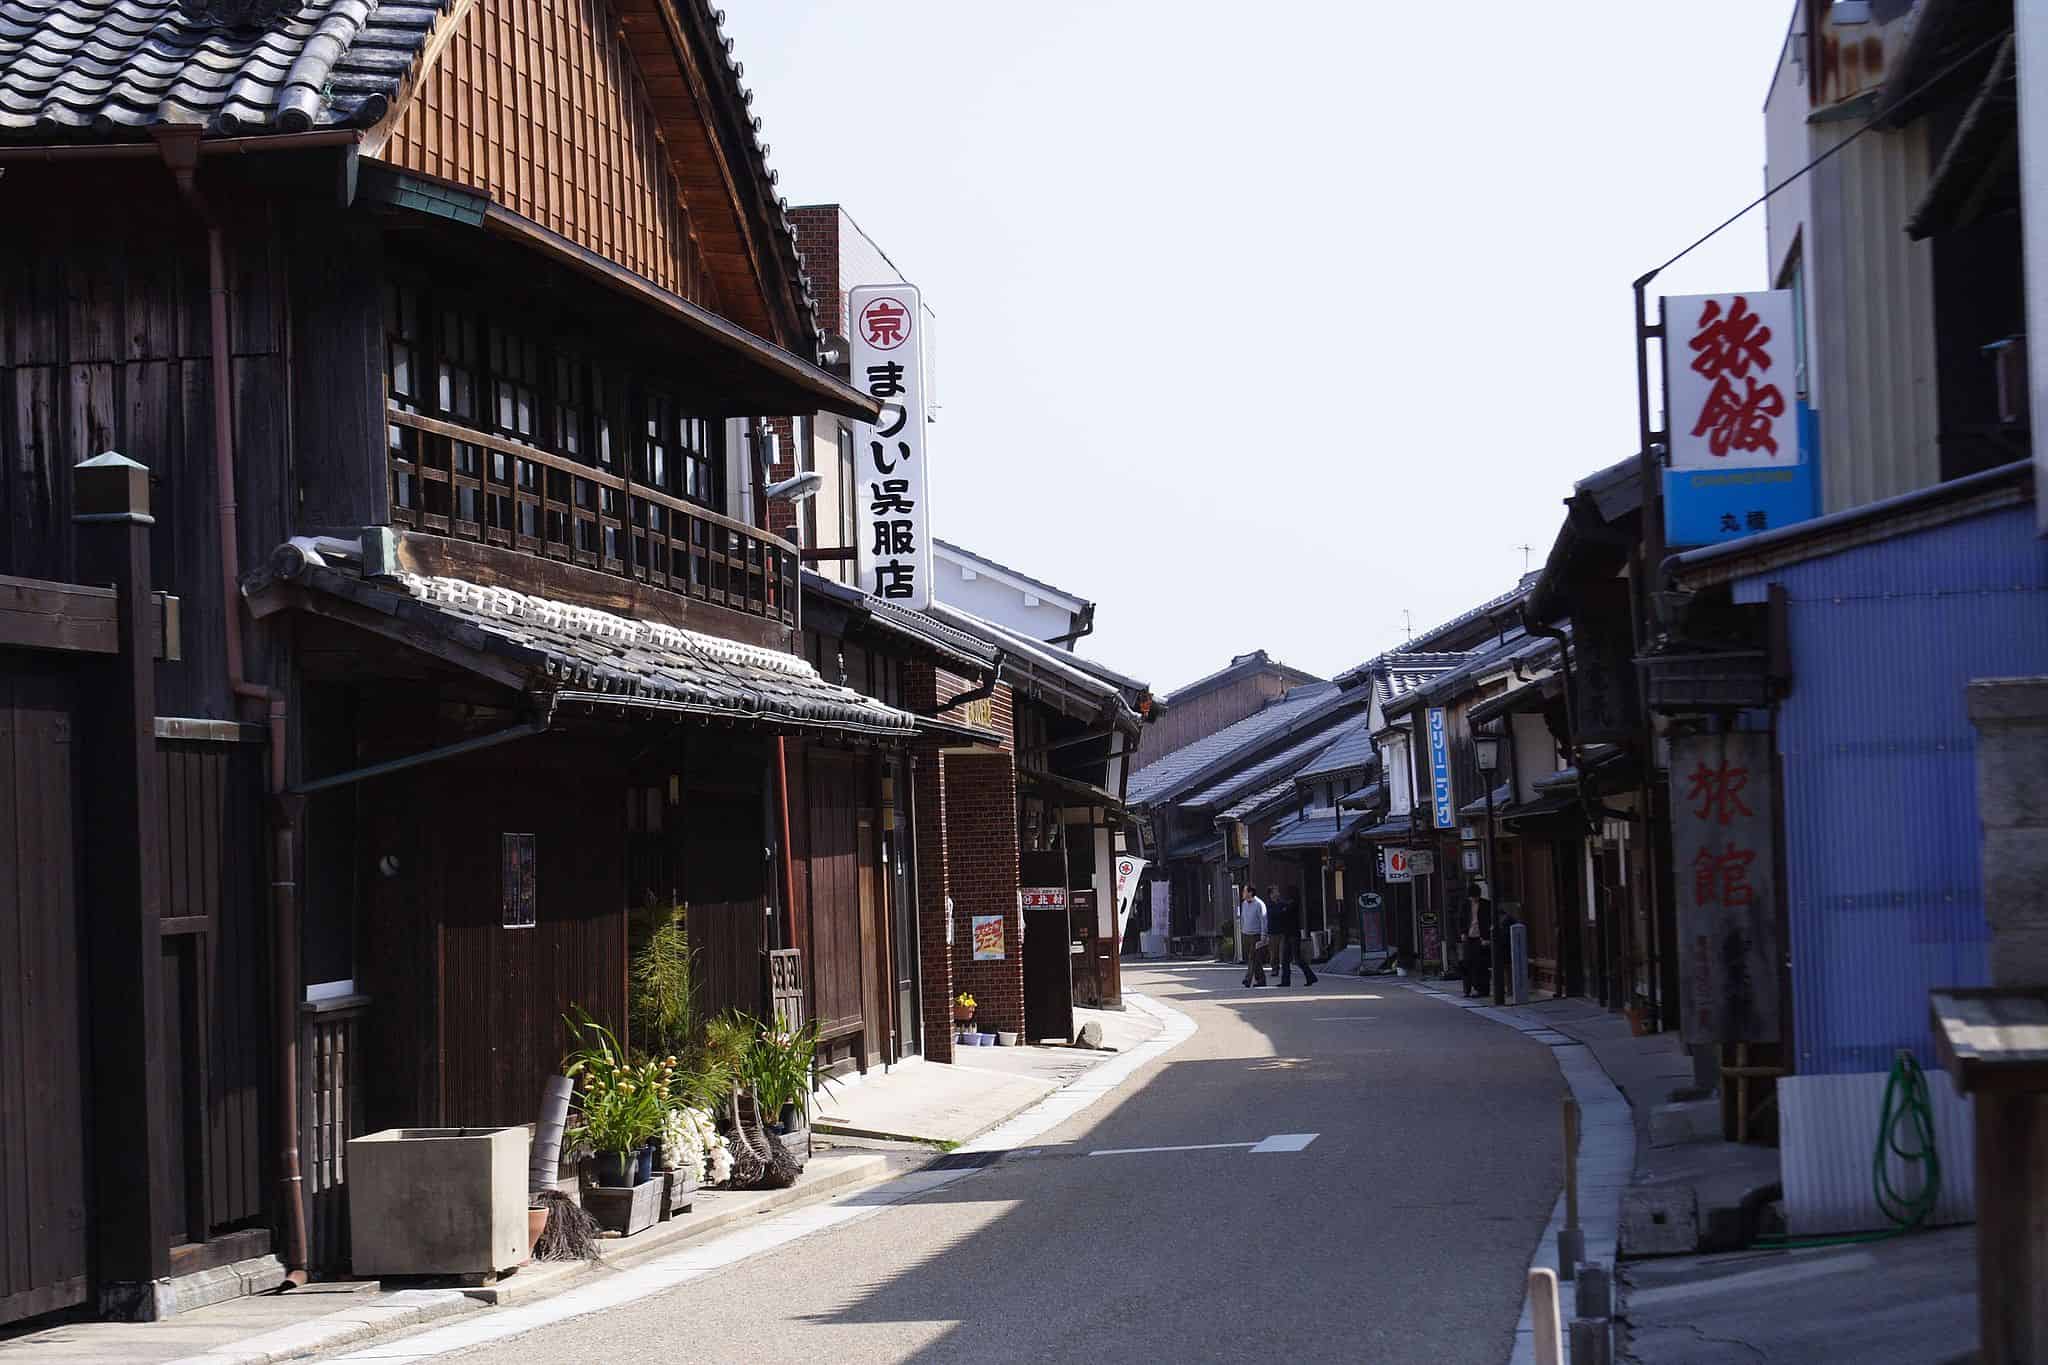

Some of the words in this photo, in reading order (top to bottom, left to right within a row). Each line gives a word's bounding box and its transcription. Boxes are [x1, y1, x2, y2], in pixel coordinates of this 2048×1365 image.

[865, 301, 907, 347] 京
[1689, 296, 1785, 457] 旅館
[1431, 711, 1449, 824] クリーニング
[1686, 759, 1756, 908] 旅館
